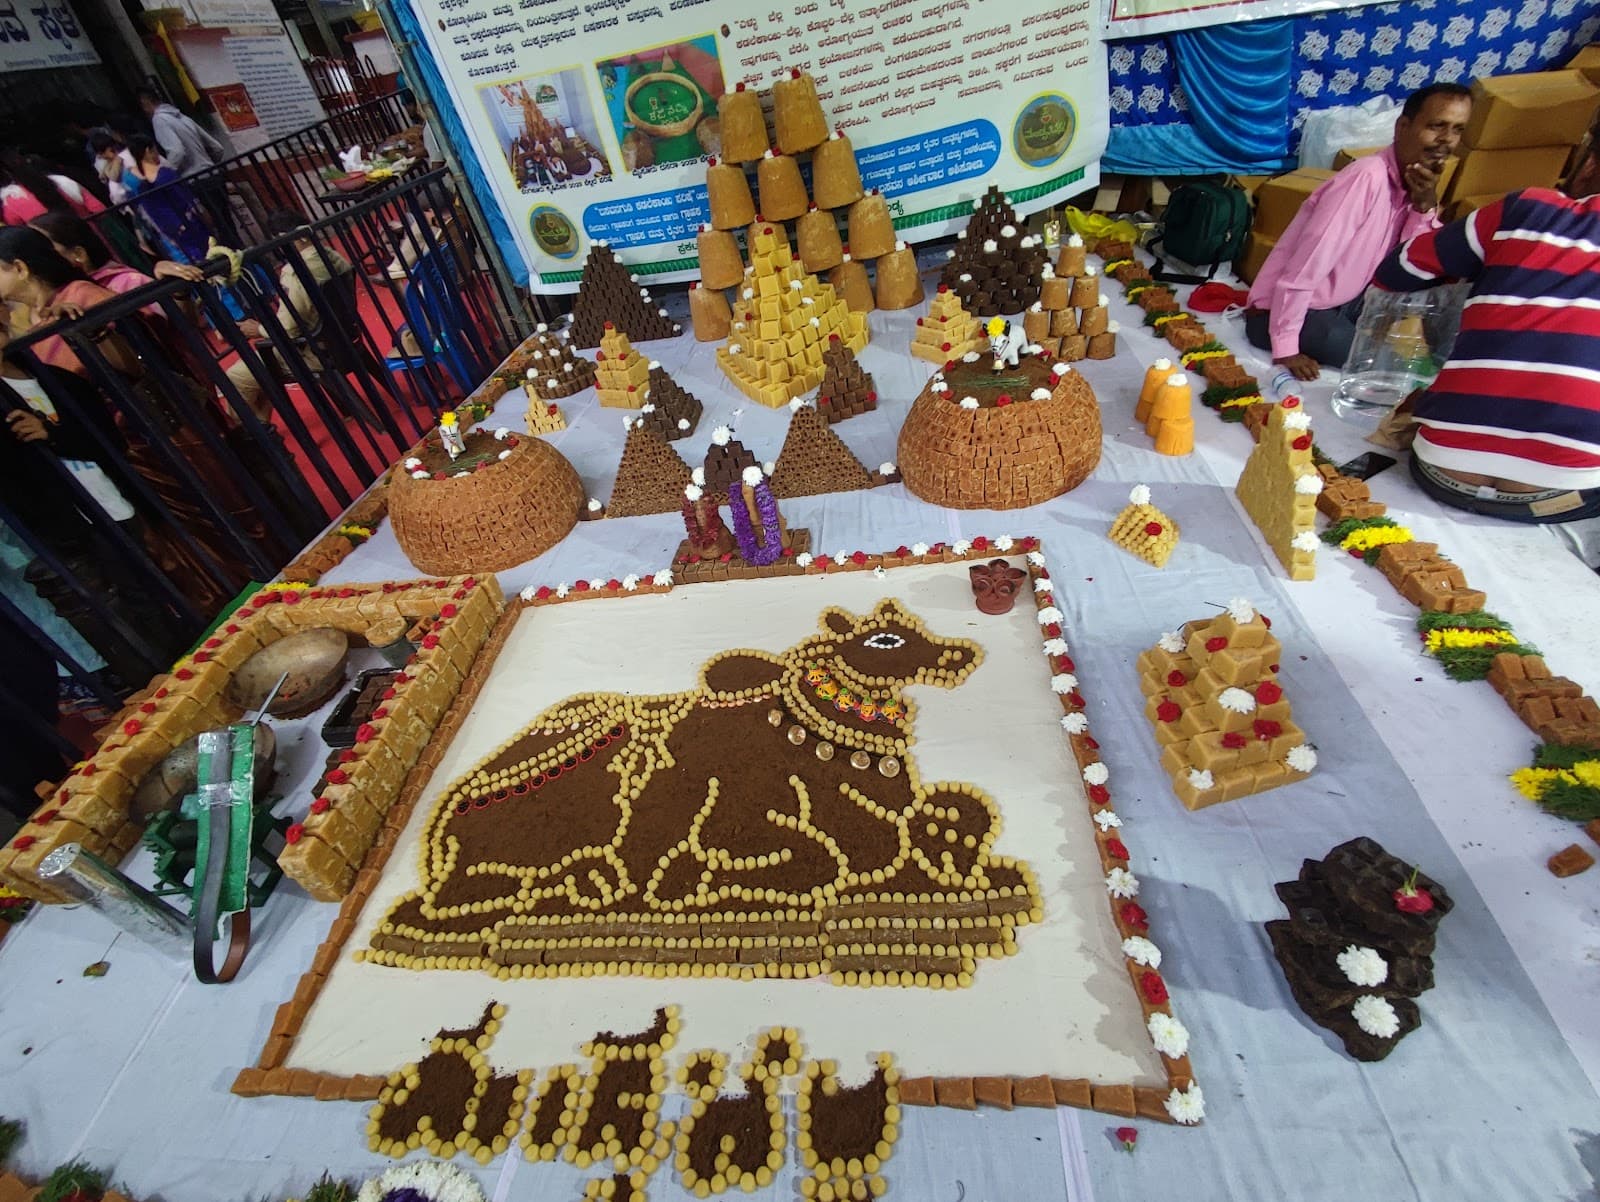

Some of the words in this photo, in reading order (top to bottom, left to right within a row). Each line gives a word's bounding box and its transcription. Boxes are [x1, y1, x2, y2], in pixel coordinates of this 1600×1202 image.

[493, 5, 514, 16] ಮತ್ತು
[768, 10, 784, 23] ಬೆಲ್ಲ
[453, 34, 470, 45] ಮತ್ತು
[1065, 56, 1089, 69] ಒಂದು
[894, 86, 915, 99] ಬೆಲ್ಲದ
[647, 228, 665, 240] ಮತ್ತು
